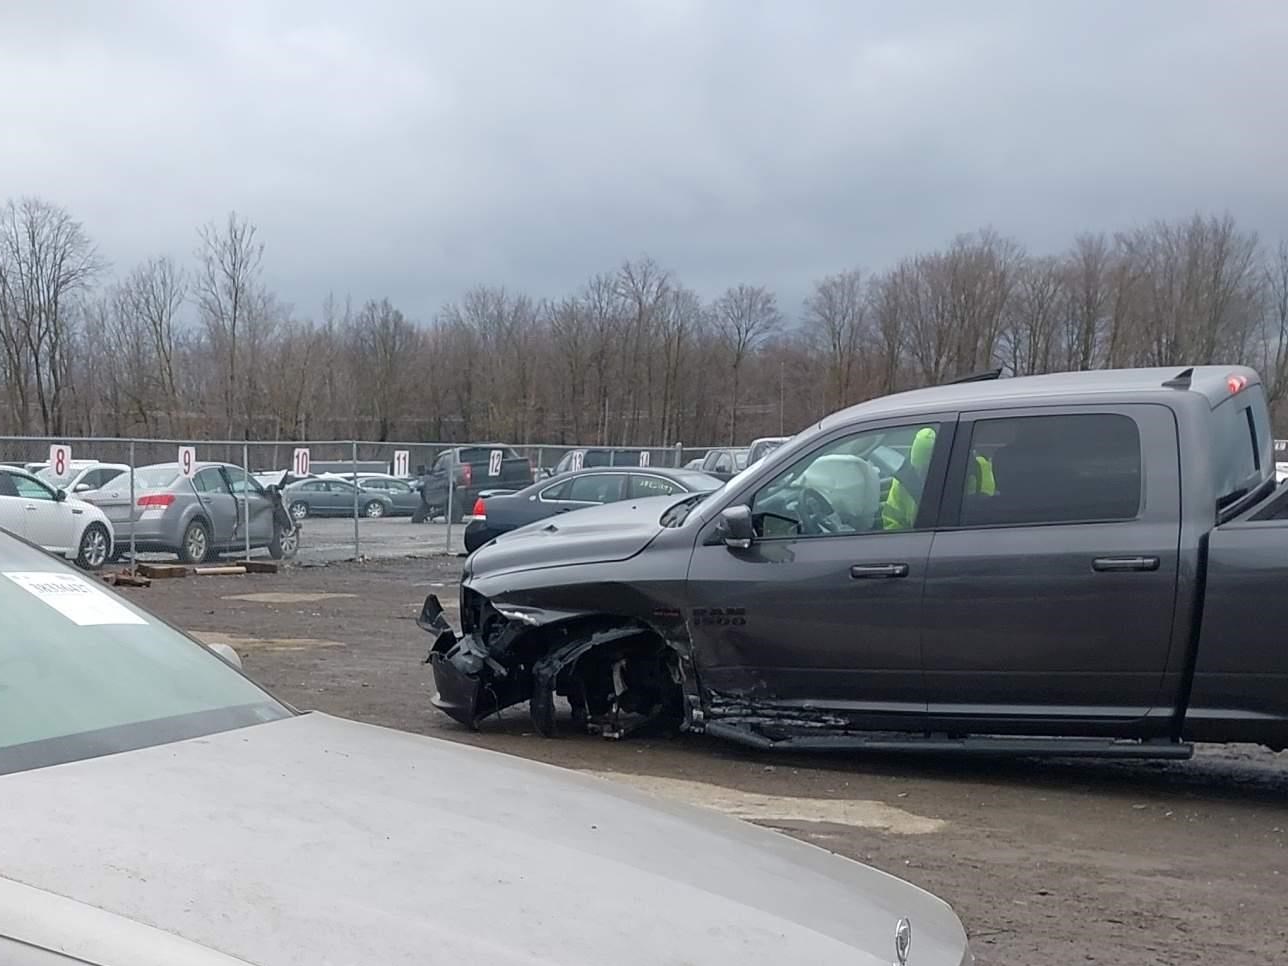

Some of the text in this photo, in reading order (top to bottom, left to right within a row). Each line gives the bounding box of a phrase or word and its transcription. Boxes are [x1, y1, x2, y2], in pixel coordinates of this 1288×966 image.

[55, 448, 65, 476] 8
[183, 450, 191, 475] 9
[295, 451, 309, 475] 10
[396, 453, 407, 475] 11
[491, 453, 501, 473] 12
